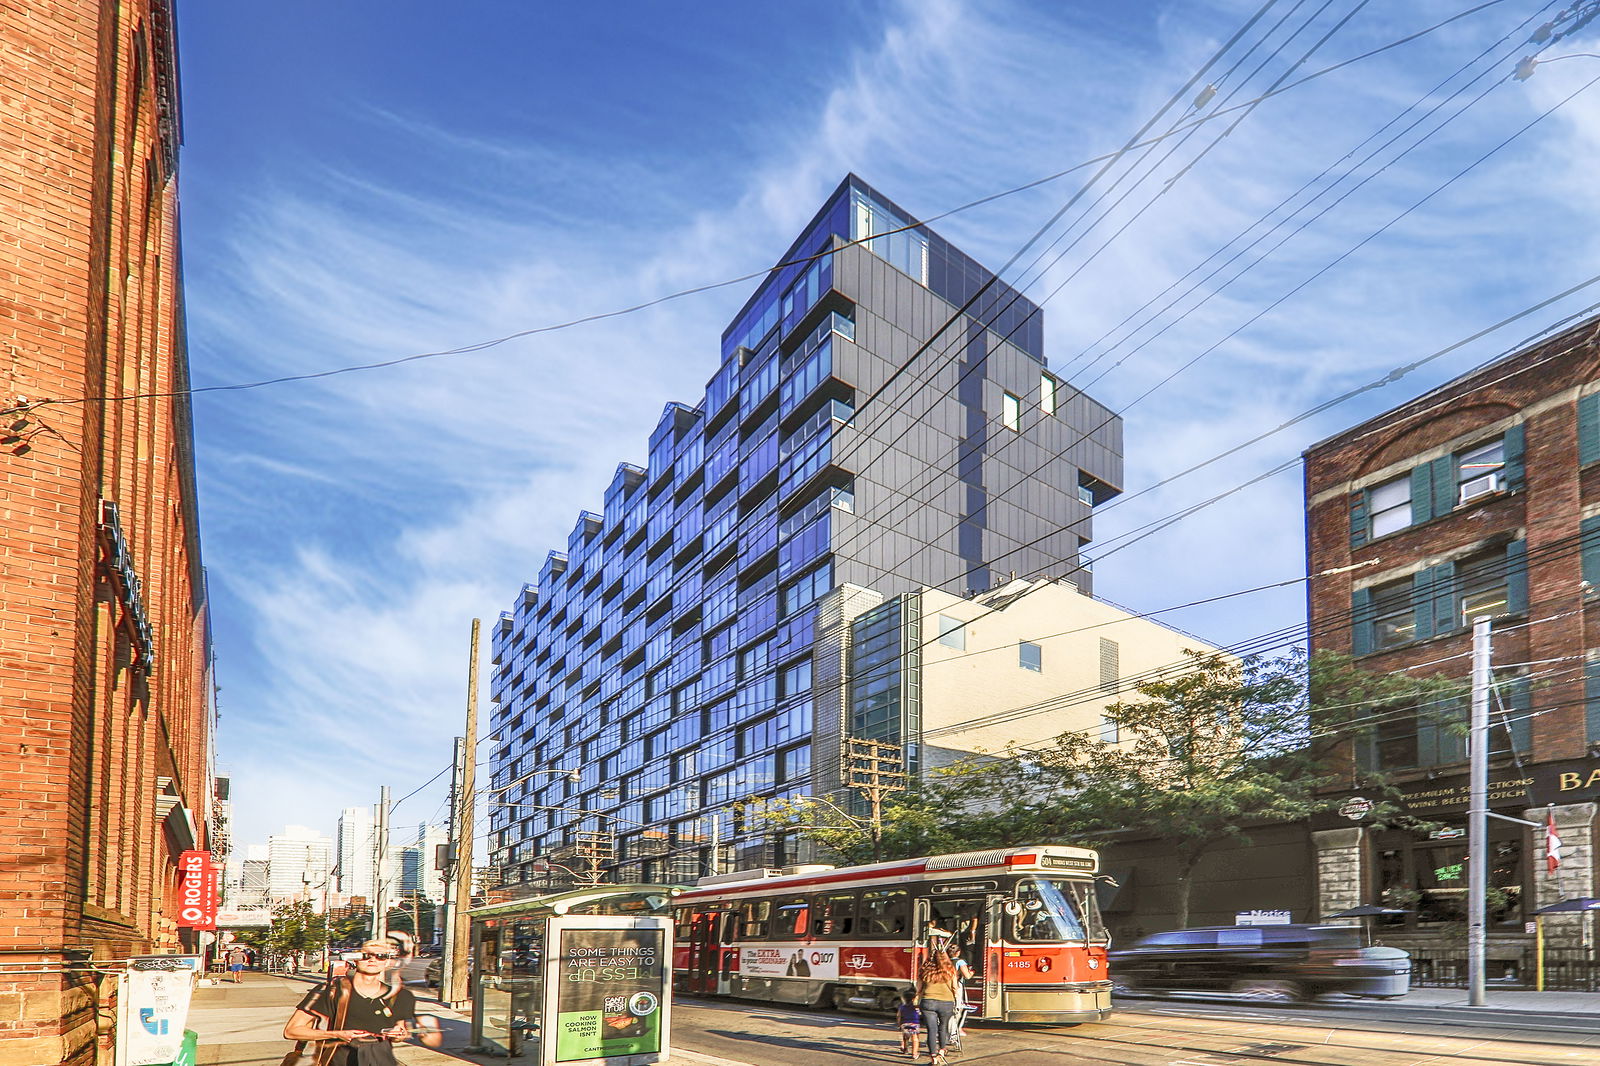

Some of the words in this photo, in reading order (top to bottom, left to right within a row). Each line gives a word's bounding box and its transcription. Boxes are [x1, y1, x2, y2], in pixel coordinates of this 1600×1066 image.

[1407, 800, 1439, 809] WINE
[1441, 795, 1471, 806] BEER
[185, 857, 203, 906] ROGERS
[1250, 909, 1291, 918] Notice
[569, 947, 606, 957] SOME
[610, 947, 655, 956] THINGS
[757, 949, 781, 958] EXTRA
[568, 957, 597, 968] ARE
[599, 957, 634, 967] EASY
[637, 957, 655, 966] TO
[810, 951, 835, 966] Q107
[568, 968, 596, 982] UP
[564, 1020, 598, 1028] COOKING
